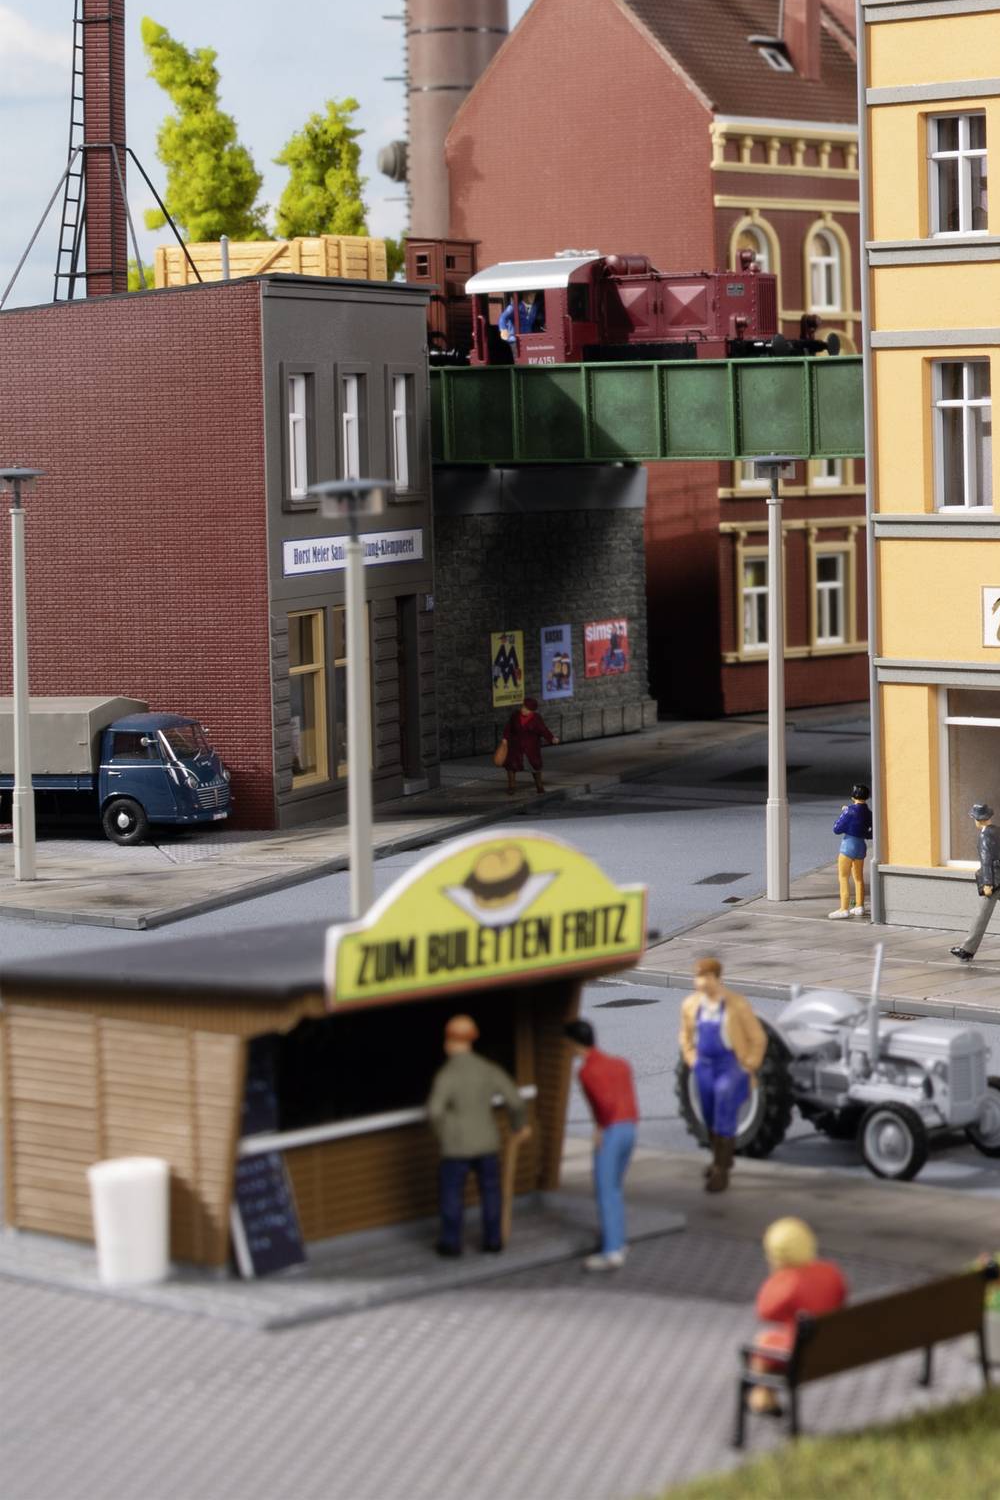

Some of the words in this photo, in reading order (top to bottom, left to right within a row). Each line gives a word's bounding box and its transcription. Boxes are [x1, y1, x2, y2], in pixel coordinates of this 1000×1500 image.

[293, 547, 310, 565] Horst
[312, 545, 329, 563] Meier
[357, 933, 417, 987] ZUM
[426, 915, 552, 976] BULETTEN
[561, 904, 628, 951] FRITZ
